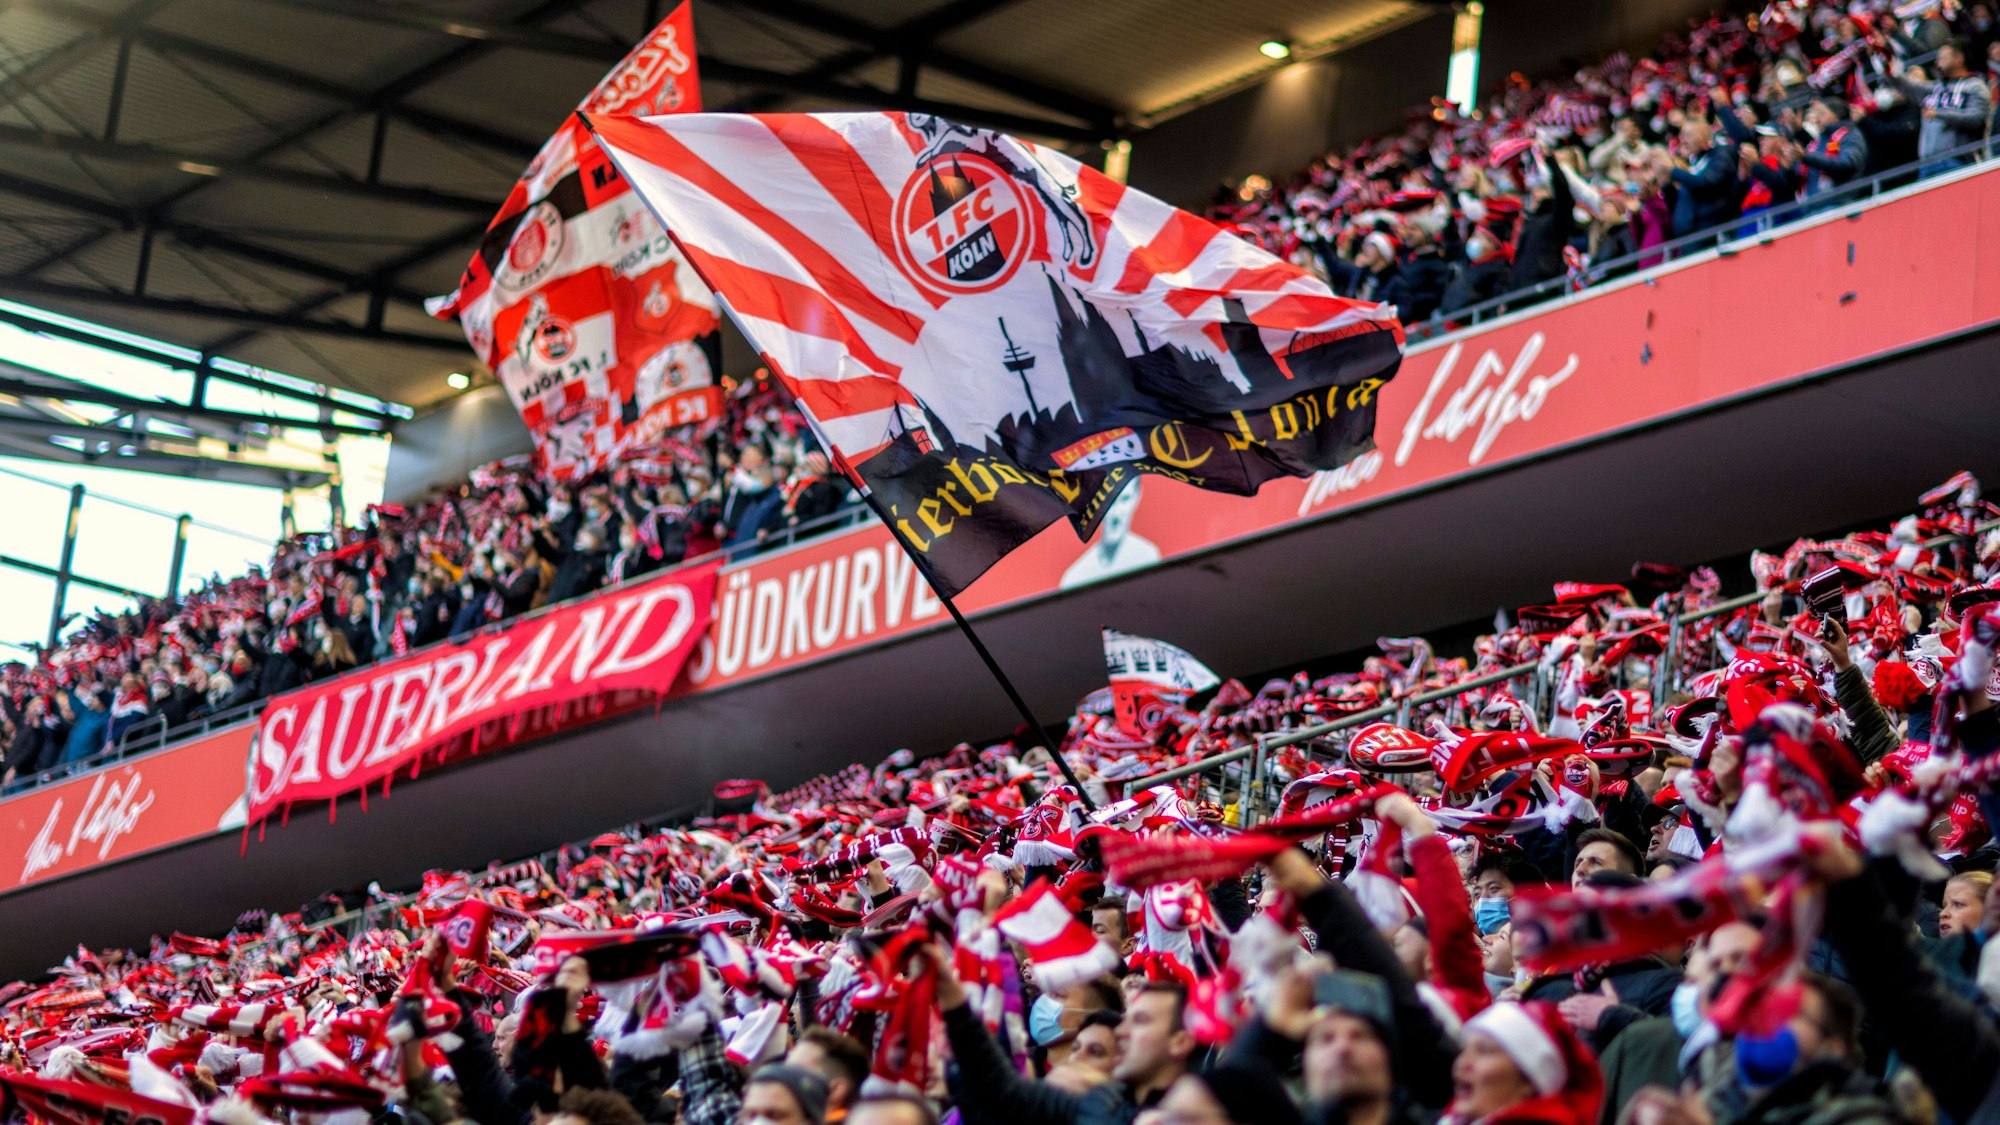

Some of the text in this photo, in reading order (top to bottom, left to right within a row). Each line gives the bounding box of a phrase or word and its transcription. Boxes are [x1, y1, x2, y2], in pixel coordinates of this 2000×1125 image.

[926, 187, 995, 255] 1.FC
[948, 231, 996, 278] KÖLN
[250, 583, 697, 807] SAUERLAND
